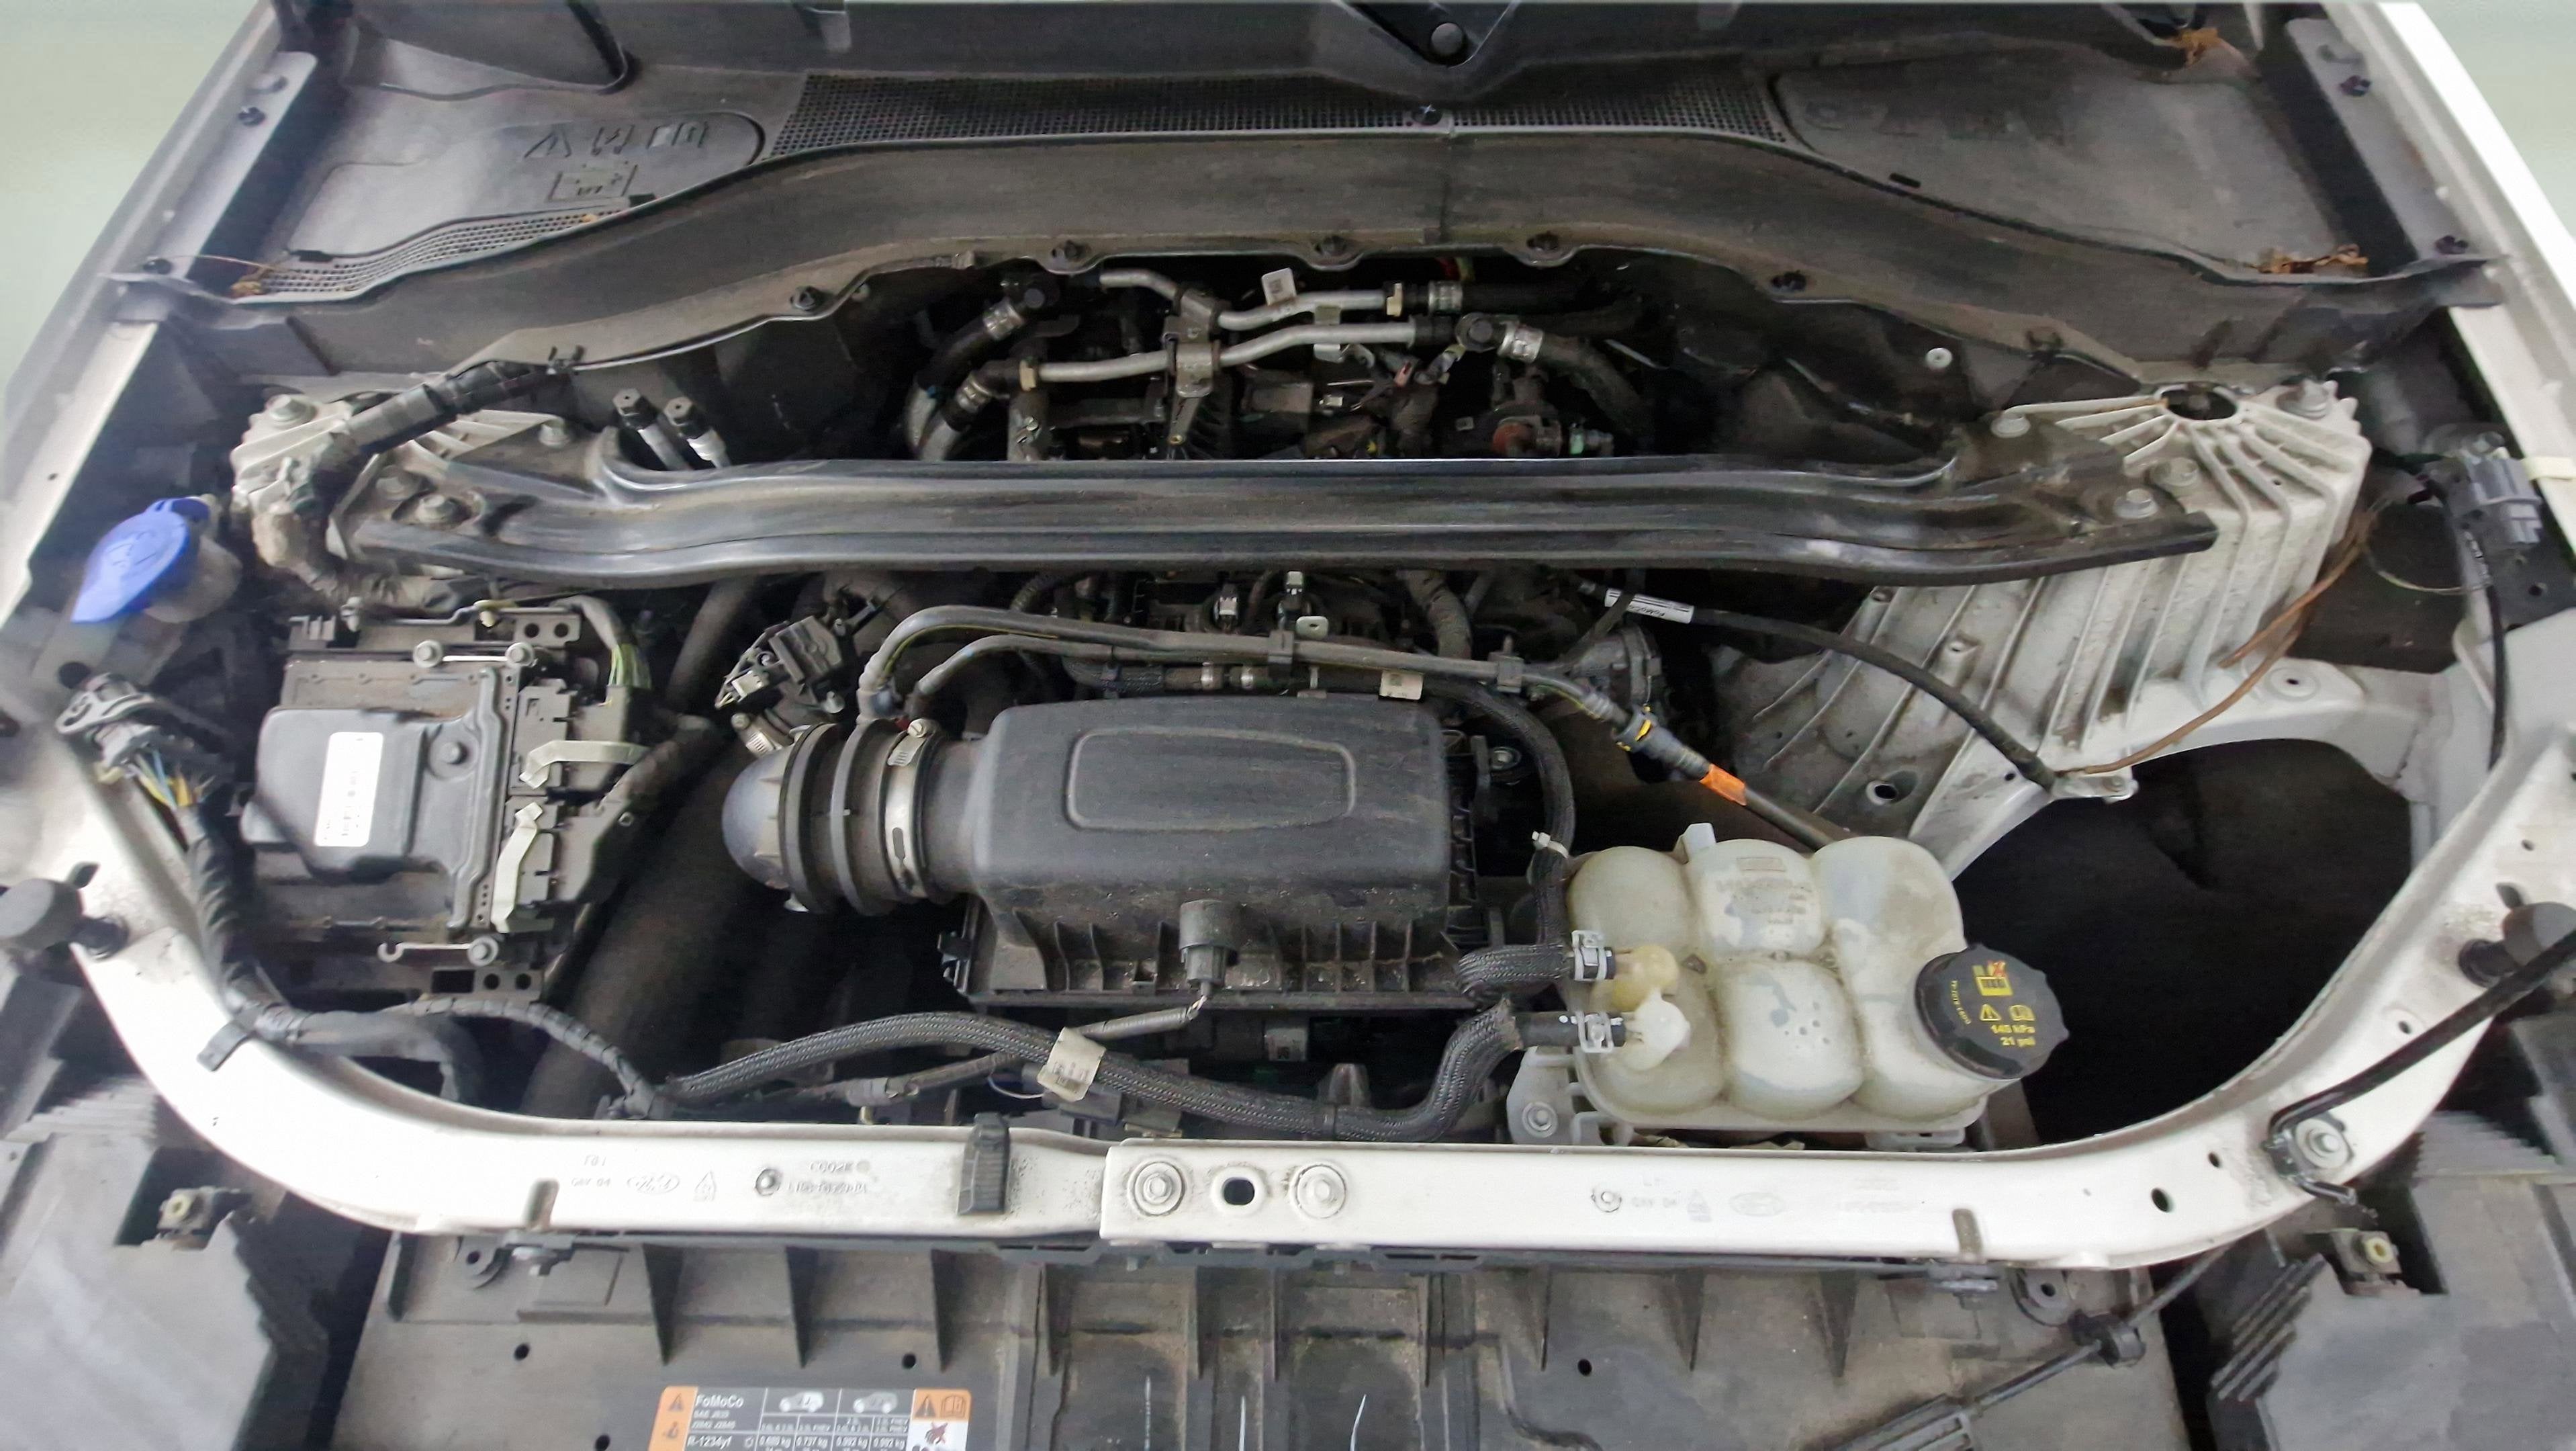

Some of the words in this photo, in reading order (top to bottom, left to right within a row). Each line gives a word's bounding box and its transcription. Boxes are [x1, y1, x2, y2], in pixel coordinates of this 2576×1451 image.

[2012, 1024, 2035, 1034] kPa
[2000, 1037, 2016, 1045] 21
[2017, 1037, 2036, 1047] psi
[695, 1394, 744, 1408] FoMoCo
[687, 1435, 733, 1450] R-1234yf
[781, 1436, 792, 1449] kg
[817, 1437, 828, 1450] kg
[858, 1436, 868, 1450] kg
[895, 1438, 905, 1450] kg
